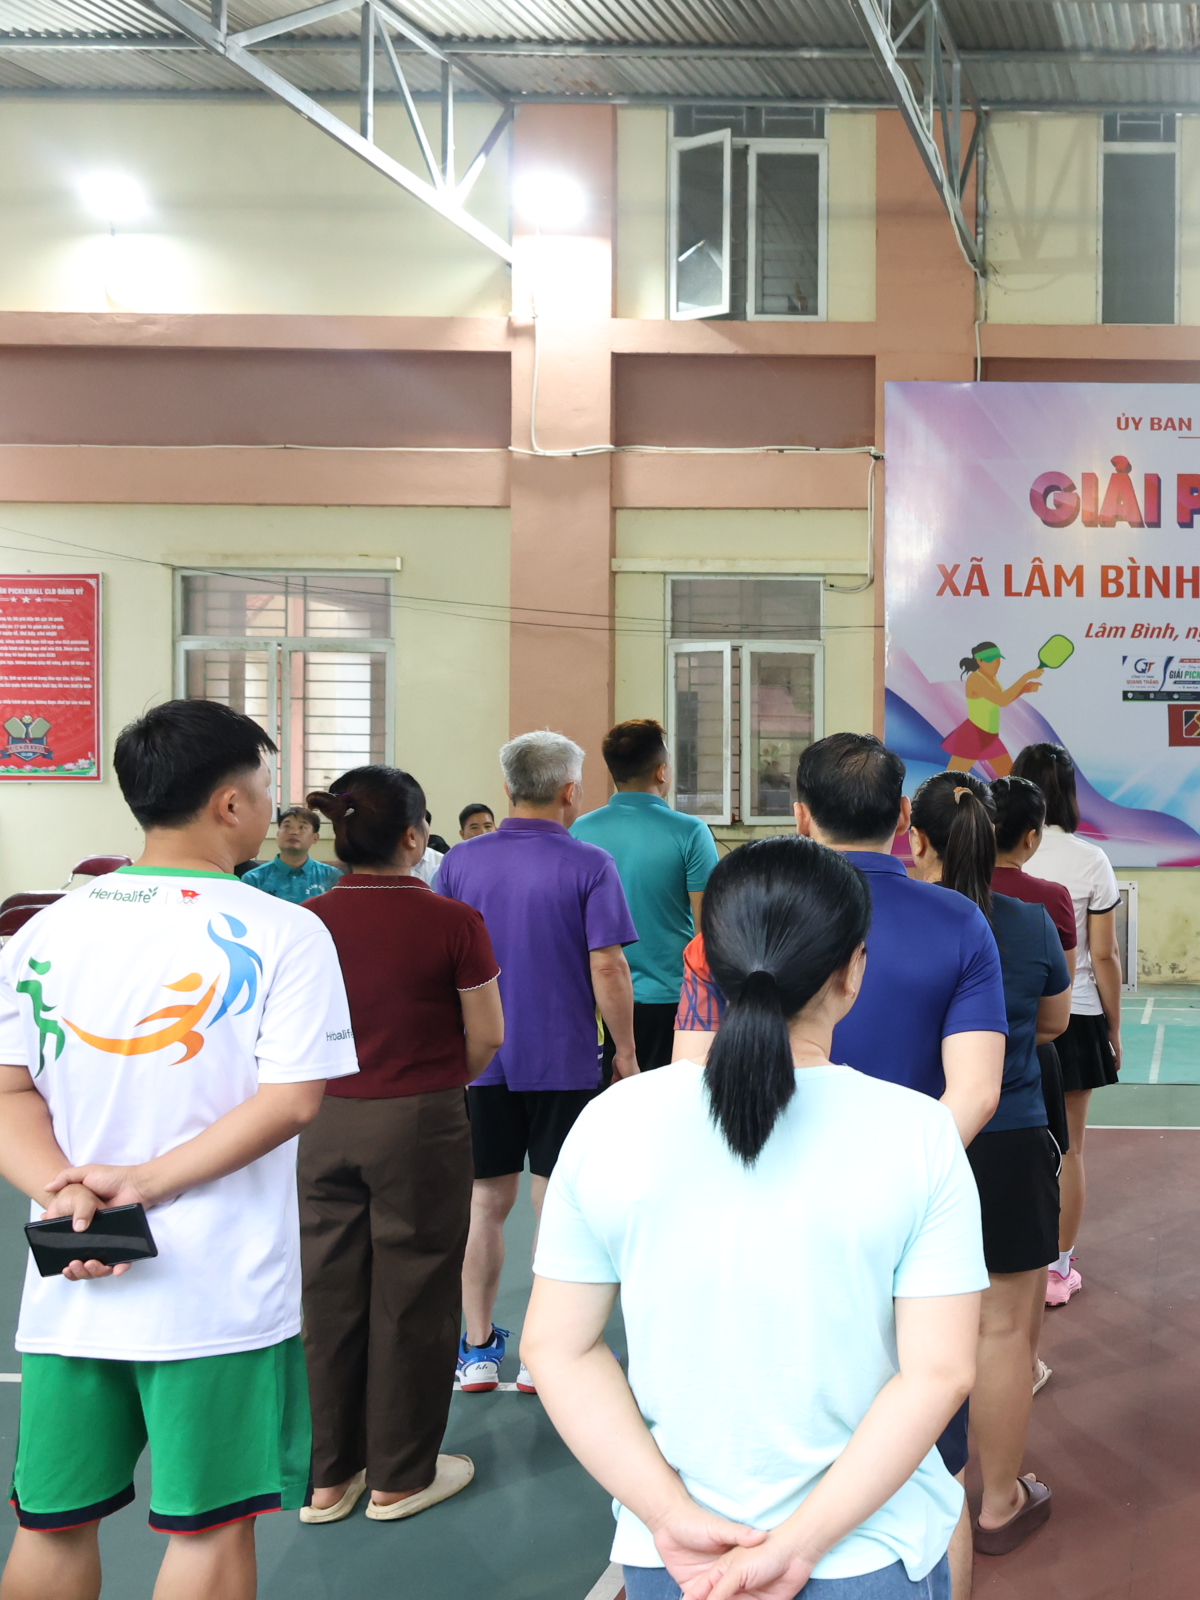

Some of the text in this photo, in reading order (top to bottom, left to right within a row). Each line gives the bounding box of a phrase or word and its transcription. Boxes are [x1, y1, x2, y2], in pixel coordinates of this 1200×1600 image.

[1116, 413, 1143, 431] ỦY
[1150, 417, 1192, 431] BAN
[1029, 455, 1161, 528] GIẢI
[935, 557, 990, 597] XÃ
[1004, 557, 1085, 598] LÂM
[1100, 557, 1200, 599] BÌNH
[1085, 622, 1126, 638] Lâm
[1130, 622, 1180, 641] Bình,
[1169, 668, 1183, 680] GIẢI
[89, 888, 151, 903] Herbalife
